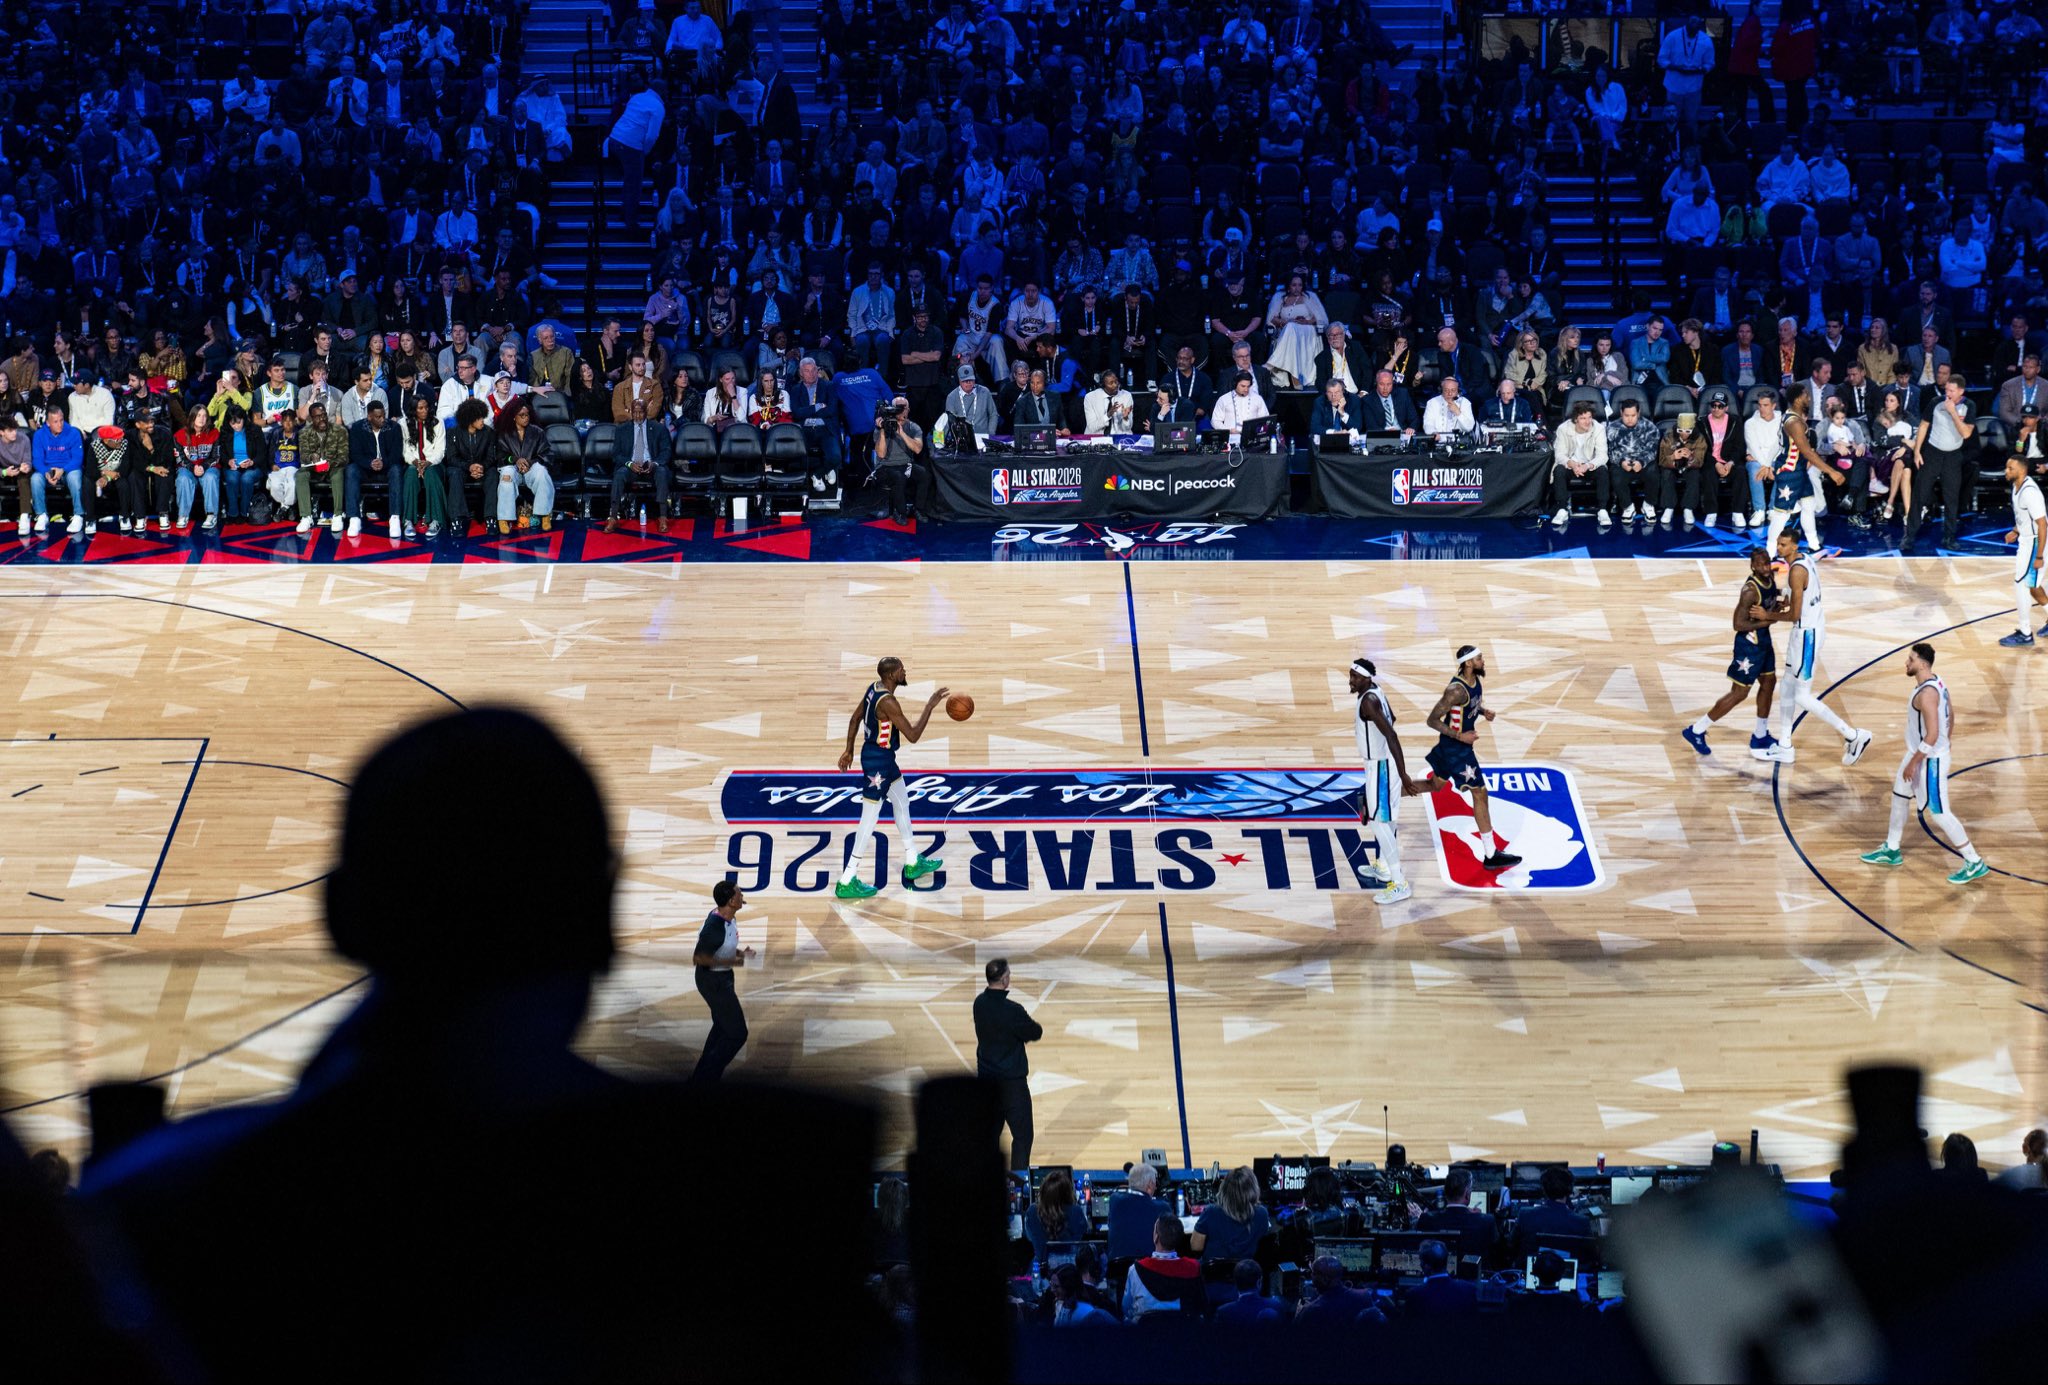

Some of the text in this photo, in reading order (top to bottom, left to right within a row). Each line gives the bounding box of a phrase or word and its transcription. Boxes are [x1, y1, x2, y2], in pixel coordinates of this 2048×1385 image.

[1012, 467, 1082, 486] ALL STAR 2026
[1131, 474, 1235, 494] NBC peacock
[1412, 468, 1482, 486] ALL STAR 2026
[1034, 489, 1079, 501] Los Angeles
[1434, 489, 1479, 502] Los Angeles
[992, 523, 1079, 544] 26
[1481, 772, 1552, 792] NBA
[1050, 783, 1176, 813] Los
[725, 830, 947, 892] 2026
[968, 828, 1216, 891] STAR
[1284, 1165, 1307, 1178] Repla
[1284, 1178, 1306, 1190] Cent
